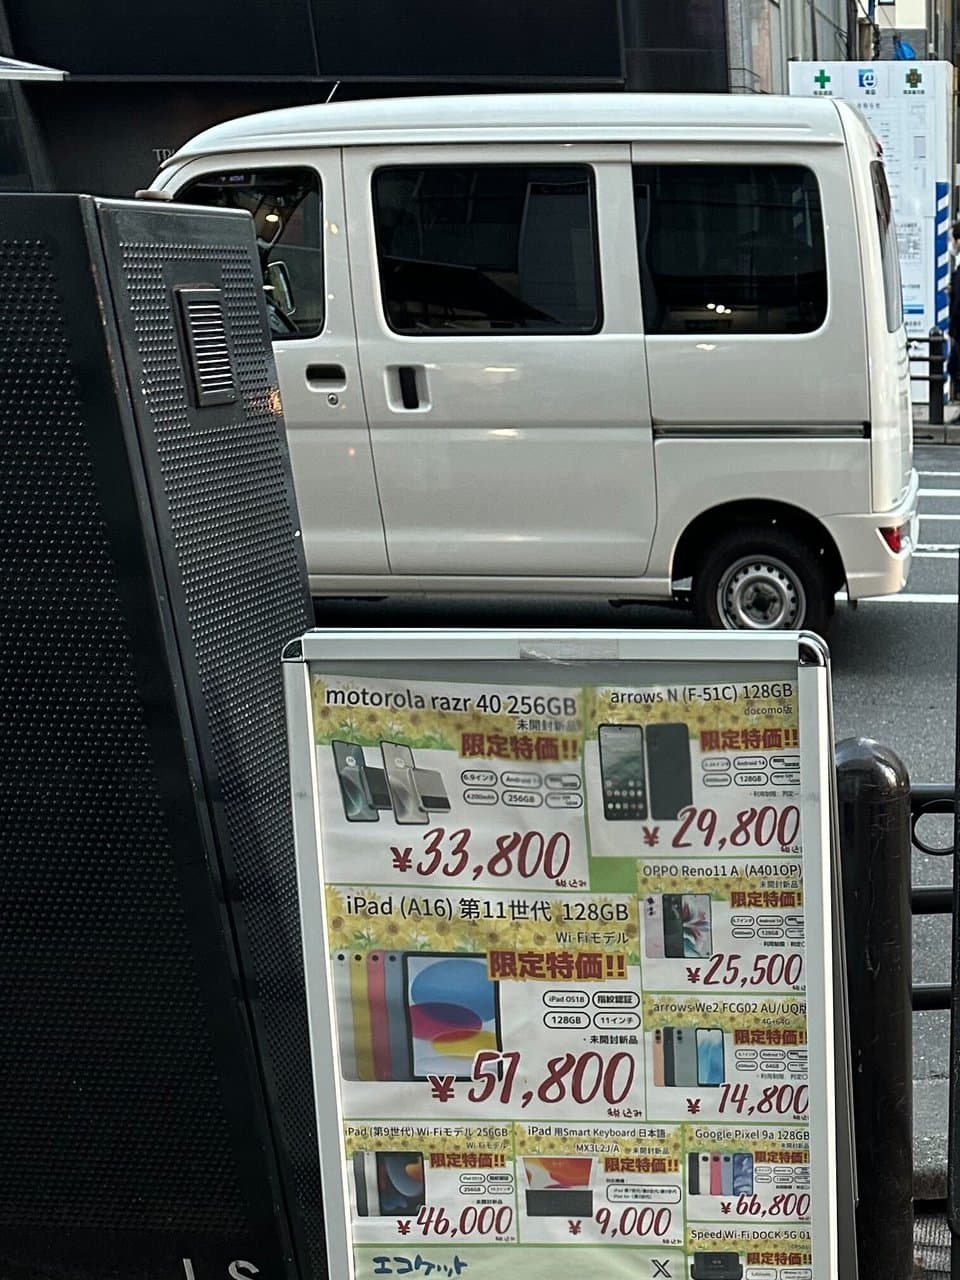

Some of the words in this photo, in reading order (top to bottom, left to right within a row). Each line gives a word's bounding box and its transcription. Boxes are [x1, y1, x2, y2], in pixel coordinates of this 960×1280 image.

[326, 689, 425, 710] motorola
[431, 697, 472, 712] razr
[476, 694, 501, 713] 40
[507, 696, 577, 717] 256GB
[611, 690, 663, 704] arrows
[667, 689, 678, 702] N
[682, 686, 738, 705] (F-51C)
[743, 683, 793, 700] 128GB
[461, 733, 577, 760] 限定特価!!
[641, 805, 801, 852] ¥29,800
[390, 827, 571, 881] ¥33,800
[643, 865, 678, 878] OPPO
[682, 865, 728, 878] Reno11
[730, 866, 739, 877] A
[347, 896, 393, 916] iPad
[400, 899, 453, 920] (A16)
[459, 897, 552, 922] 第11世代
[563, 902, 629, 921] 128GB
[556, 930, 630, 945] Wi-Fiモデル
[490, 951, 627, 979] 限定特価!!
[686, 953, 803, 988] ¥25,500
[653, 1003, 693, 1013] arrows
[694, 1002, 719, 1014] We2
[722, 1002, 758, 1014] FCG02
[551, 1016, 582, 1025] 128GB
[369, 1127, 415, 1138] (第9世代)
[416, 1128, 473, 1138] Wi-Fiモデル
[477, 1128, 508, 1138] 256GB
[528, 1126, 551, 1137] iPad
[554, 1127, 590, 1138] 用Smart
[592, 1128, 636, 1140] Keyboard
[638, 1128, 666, 1139] 日本語
[695, 1130, 731, 1140] Google
[734, 1129, 760, 1140] Pixel
[762, 1130, 775, 1140] 9a
[777, 1130, 810, 1141] 128GB
[430, 1152, 506, 1169] 限定特価!!
[604, 1158, 679, 1173] 限定特価!!
[720, 1193, 811, 1218] ¥66,800
[397, 1206, 513, 1237] ¥46,000
[568, 1207, 672, 1238] ¥9,000
[691, 1230, 722, 1242] Speed
[725, 1230, 750, 1240] Wi-Fi
[752, 1231, 782, 1240] DOCK
[784, 1231, 798, 1240] 5G
[799, 1231, 811, 1240] 01
[373, 1254, 468, 1277] エコケット
